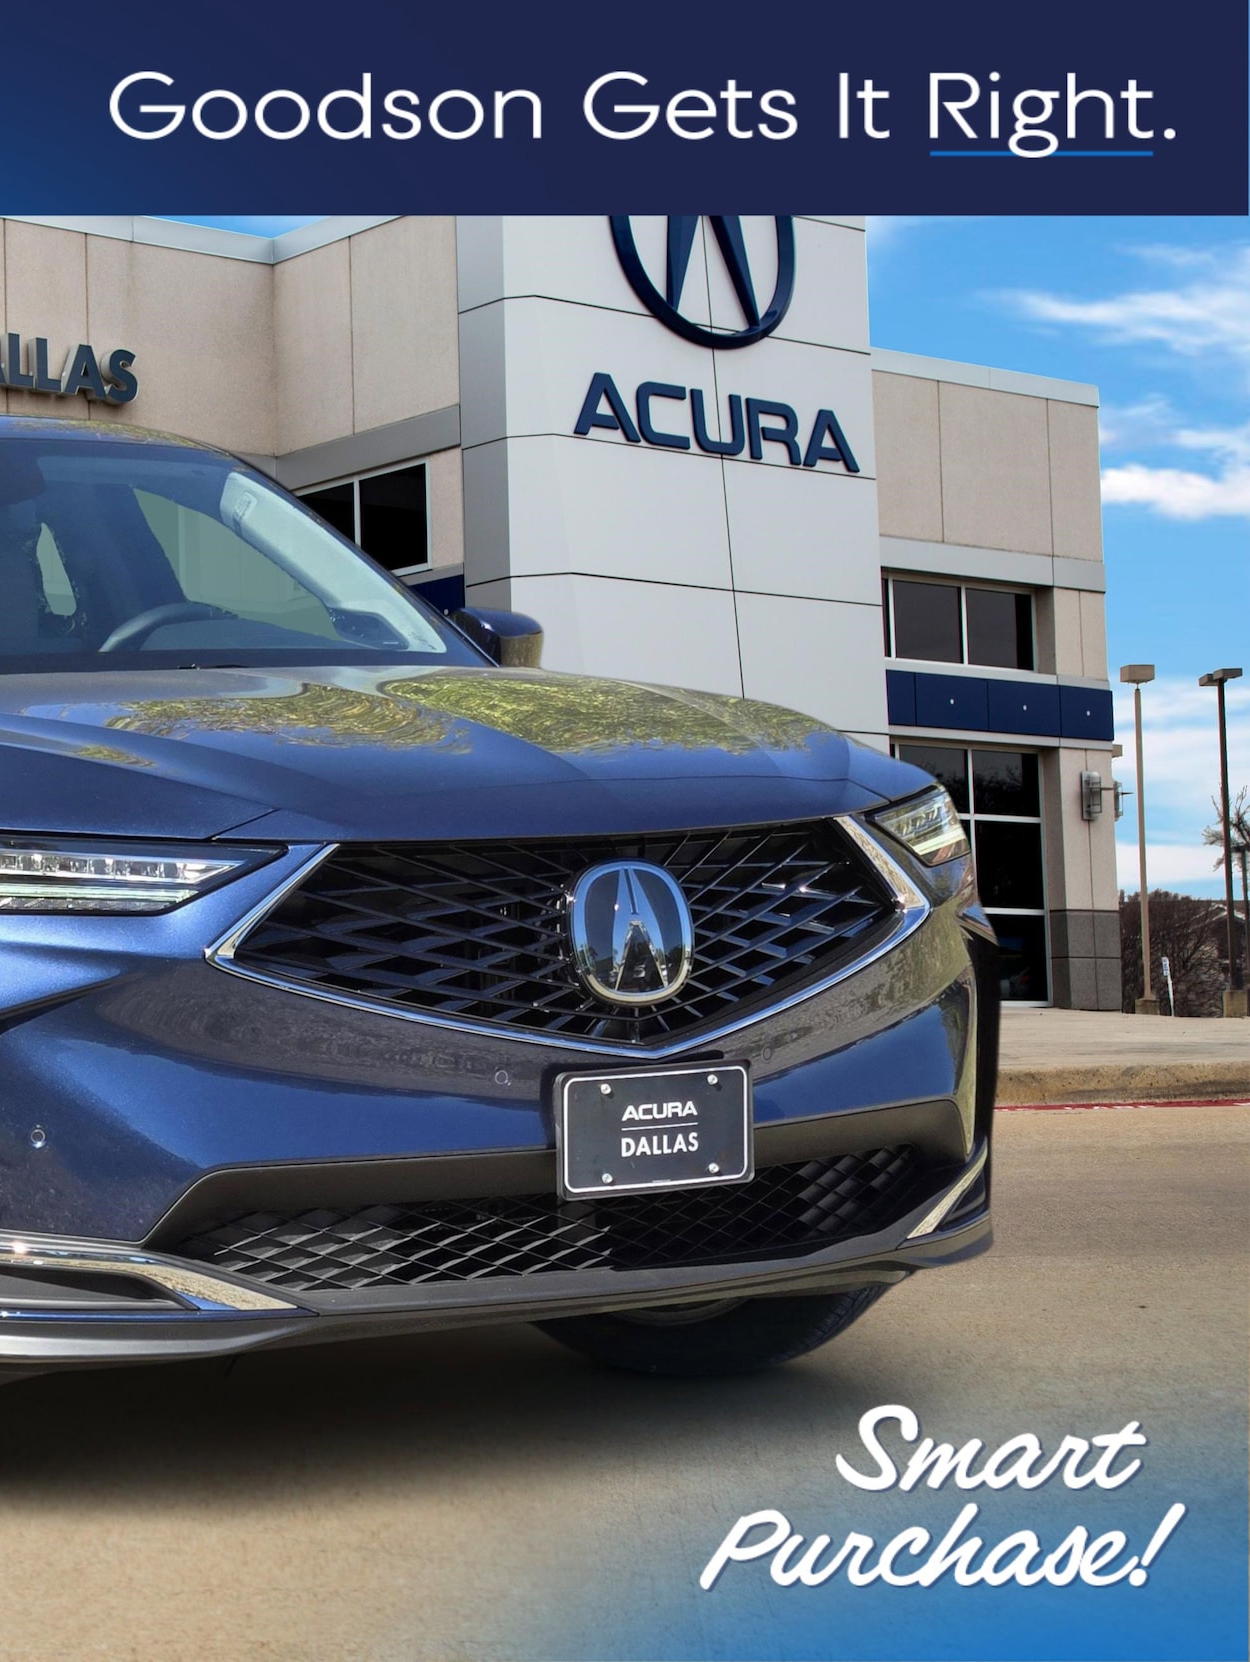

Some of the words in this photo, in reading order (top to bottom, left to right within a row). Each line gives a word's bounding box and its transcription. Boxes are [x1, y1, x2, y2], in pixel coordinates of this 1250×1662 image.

[573, 372, 860, 473] ACURA
[621, 1101, 698, 1122] ACURA
[621, 1132, 699, 1158] DALLAS
